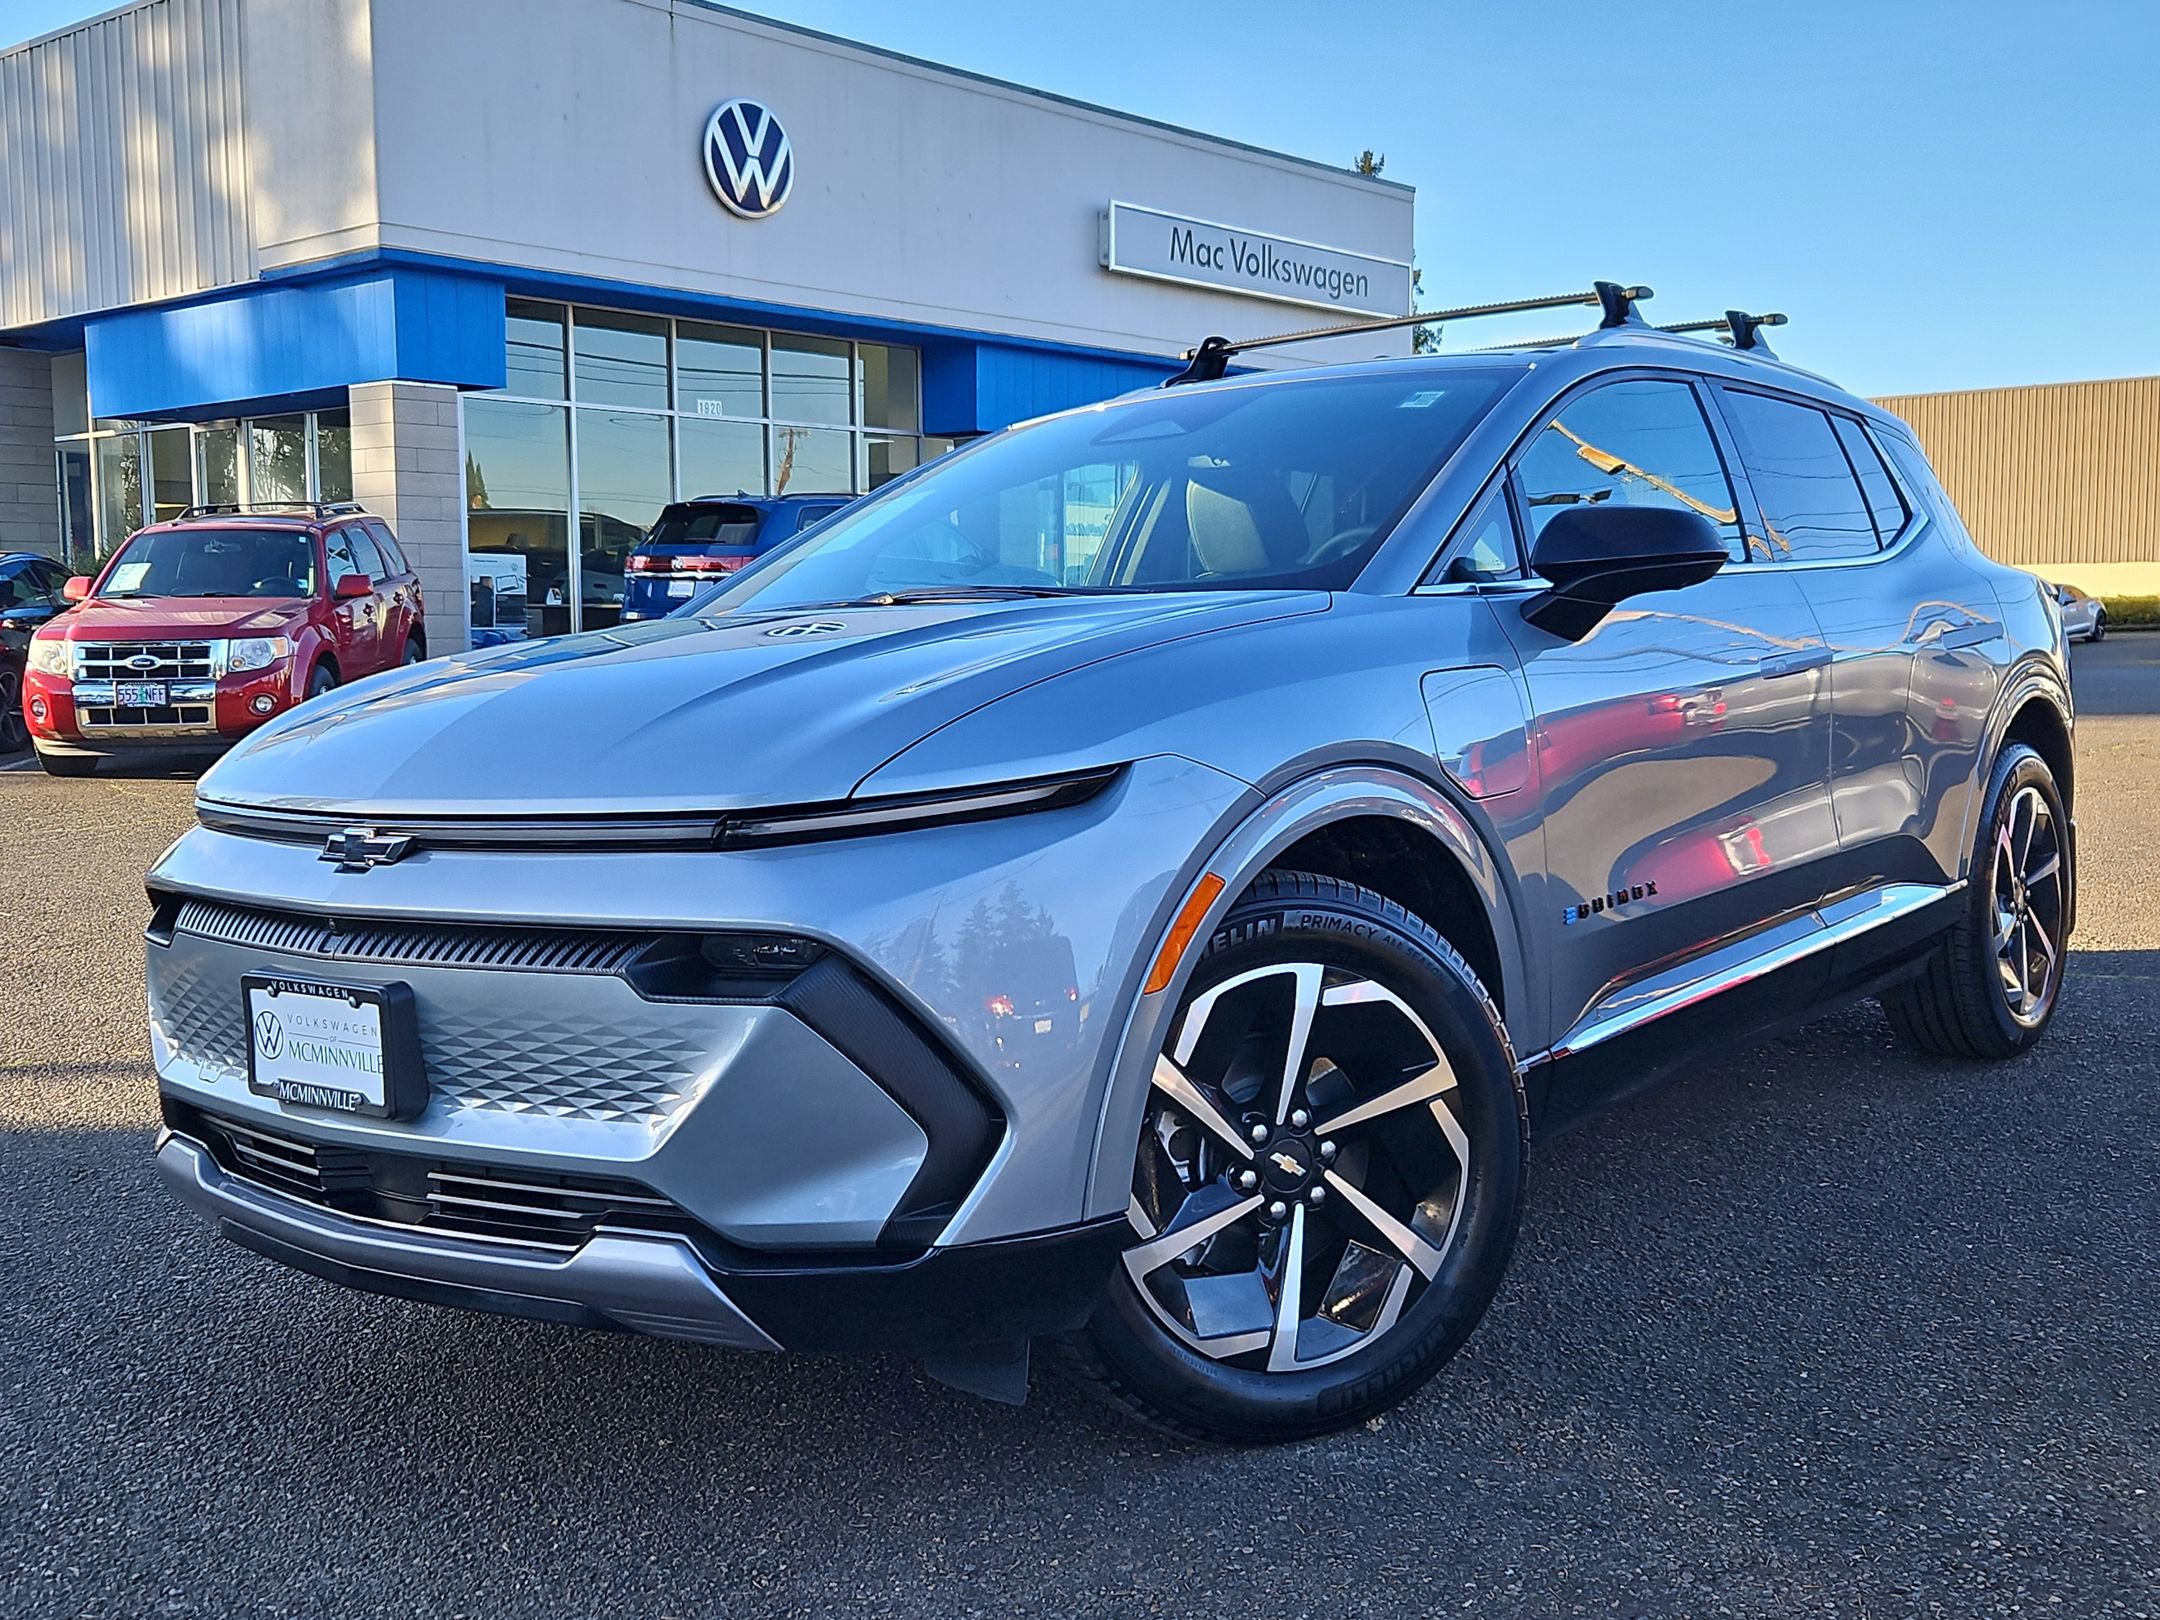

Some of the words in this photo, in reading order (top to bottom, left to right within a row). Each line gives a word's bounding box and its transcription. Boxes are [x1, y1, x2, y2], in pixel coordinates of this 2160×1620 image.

[704, 99, 794, 219] VW
[1170, 226, 1224, 271] Mac
[1229, 238, 1368, 300] Volkswagen
[699, 401, 721, 416] 1920
[1203, 918, 1276, 959] ELIN
[1301, 914, 1377, 939] PRIMACY
[1382, 934, 1404, 951] ALL
[271, 980, 349, 999] VOLKSWAGEN
[287, 1013, 378, 1037] VOLKSWAGEN
[288, 1040, 384, 1074] MCMINNVILLE
[280, 1081, 357, 1111] MCMINNVILLE
